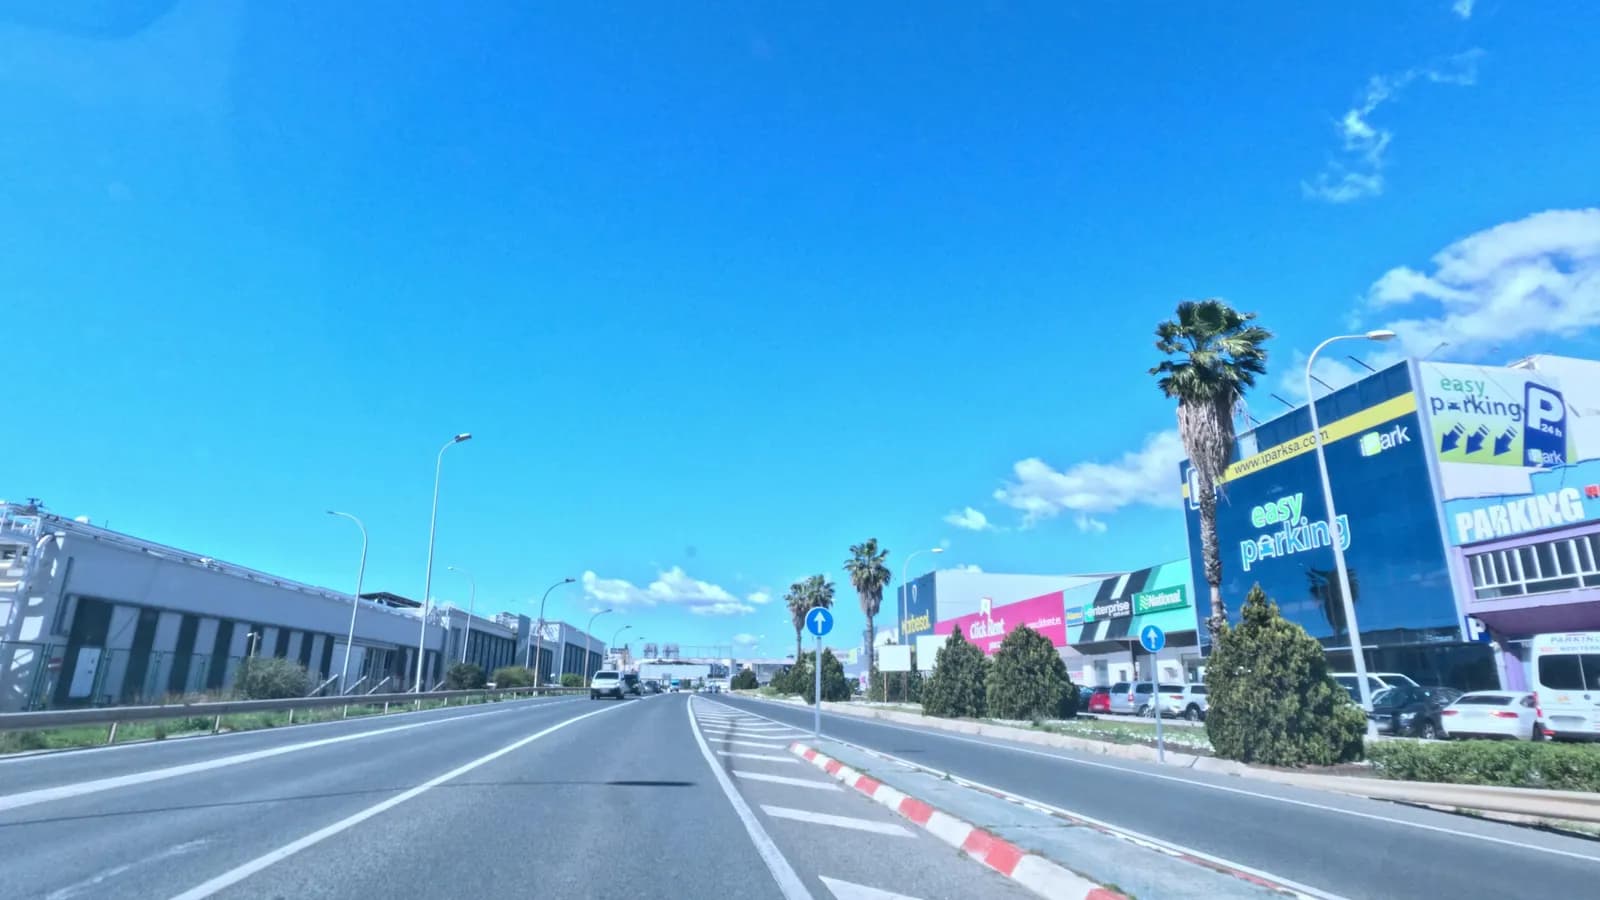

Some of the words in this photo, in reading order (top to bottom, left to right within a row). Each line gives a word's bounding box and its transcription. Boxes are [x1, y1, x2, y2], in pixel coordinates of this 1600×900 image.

[1440, 378, 1485, 397] easy
[1528, 387, 1564, 430] P
[1251, 492, 1303, 528] easy
[1455, 487, 1585, 544] PARKING
[1149, 589, 1181, 607] National
[1087, 601, 1130, 617] enterprise
[970, 620, 987, 639] Click
